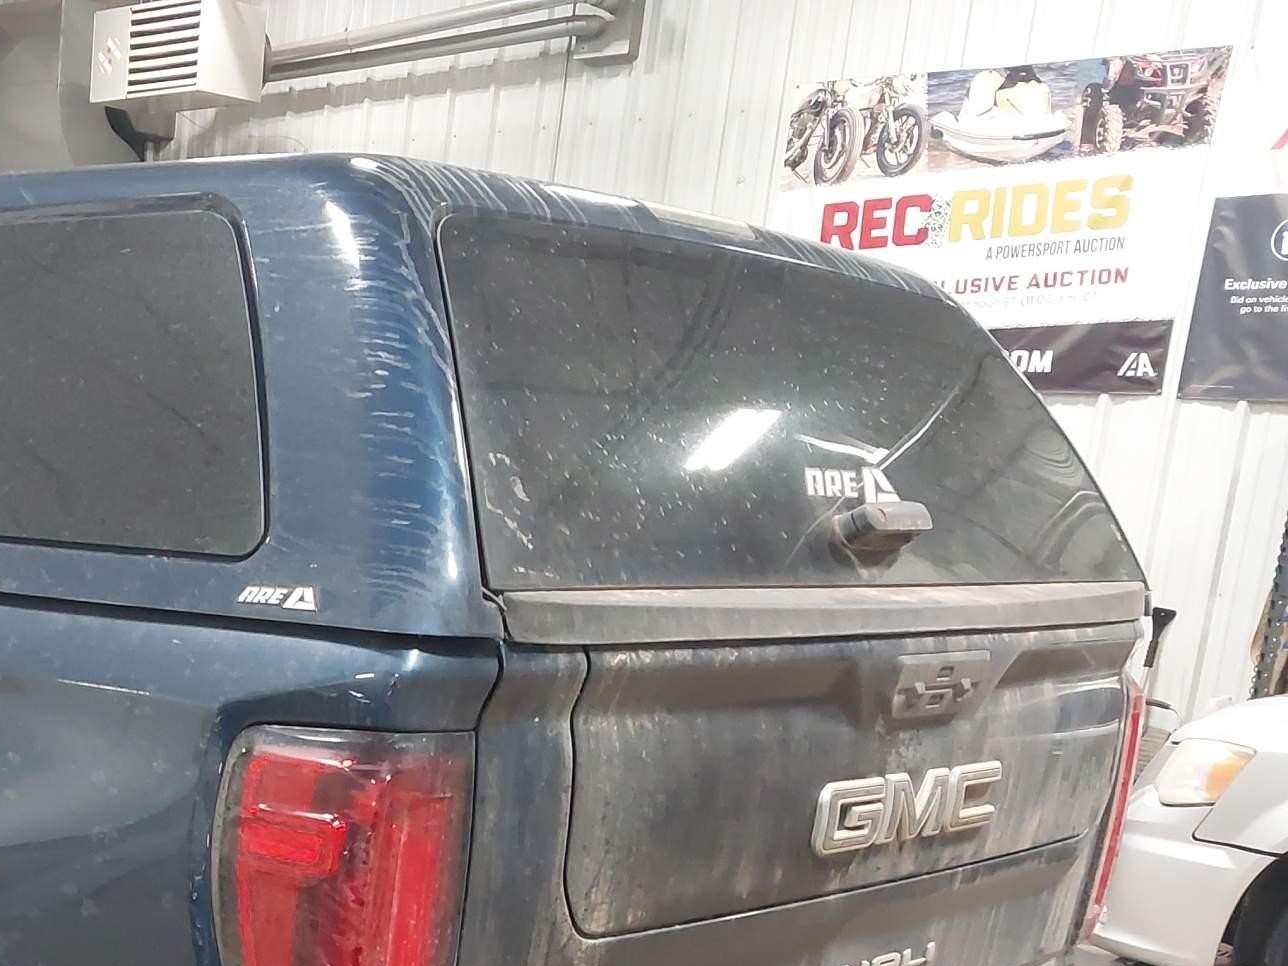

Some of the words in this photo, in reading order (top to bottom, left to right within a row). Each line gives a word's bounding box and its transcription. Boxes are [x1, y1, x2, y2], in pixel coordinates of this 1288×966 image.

[820, 193, 935, 250] REC
[947, 175, 1134, 243] RIDES
[985, 248, 993, 261] A
[995, 240, 1070, 259] POWERSPORT
[1074, 237, 1125, 253] AUCTION
[935, 275, 1020, 295] LUSIVE
[1026, 267, 1129, 290] AUCTION
[1224, 278, 1288, 290] Exclusive
[1240, 306, 1252, 314] go
[1253, 305, 1263, 313] to
[1264, 304, 1279, 313] the
[1000, 349, 1055, 373] OM
[811, 760, 1003, 858] GMC
